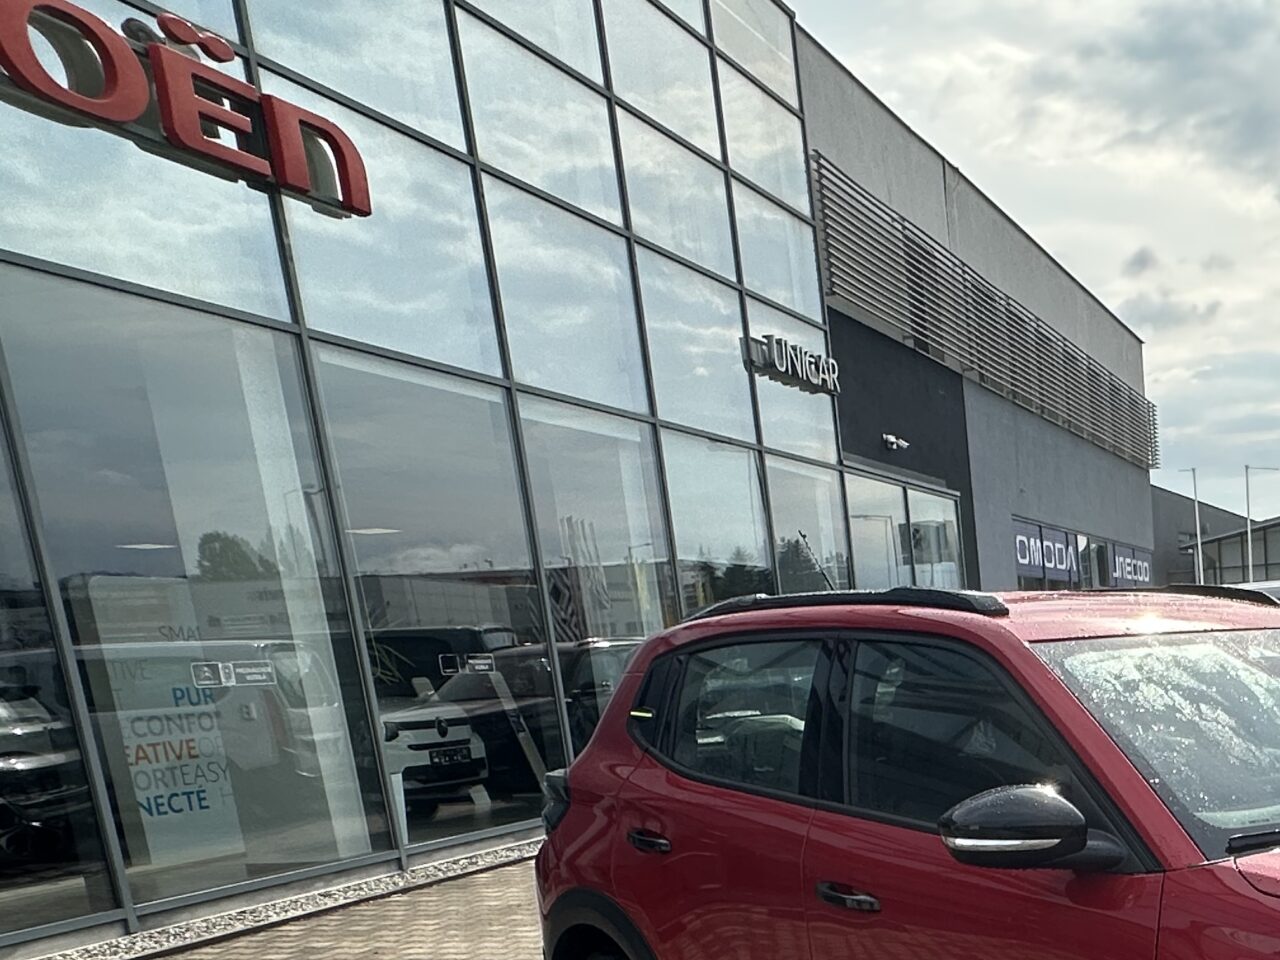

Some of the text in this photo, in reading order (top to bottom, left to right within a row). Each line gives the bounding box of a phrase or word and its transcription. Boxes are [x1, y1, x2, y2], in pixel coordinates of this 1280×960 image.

[774, 338, 841, 393] UNICAR
[1015, 534, 1077, 572] OMODA
[1112, 555, 1150, 582] JAECOO
